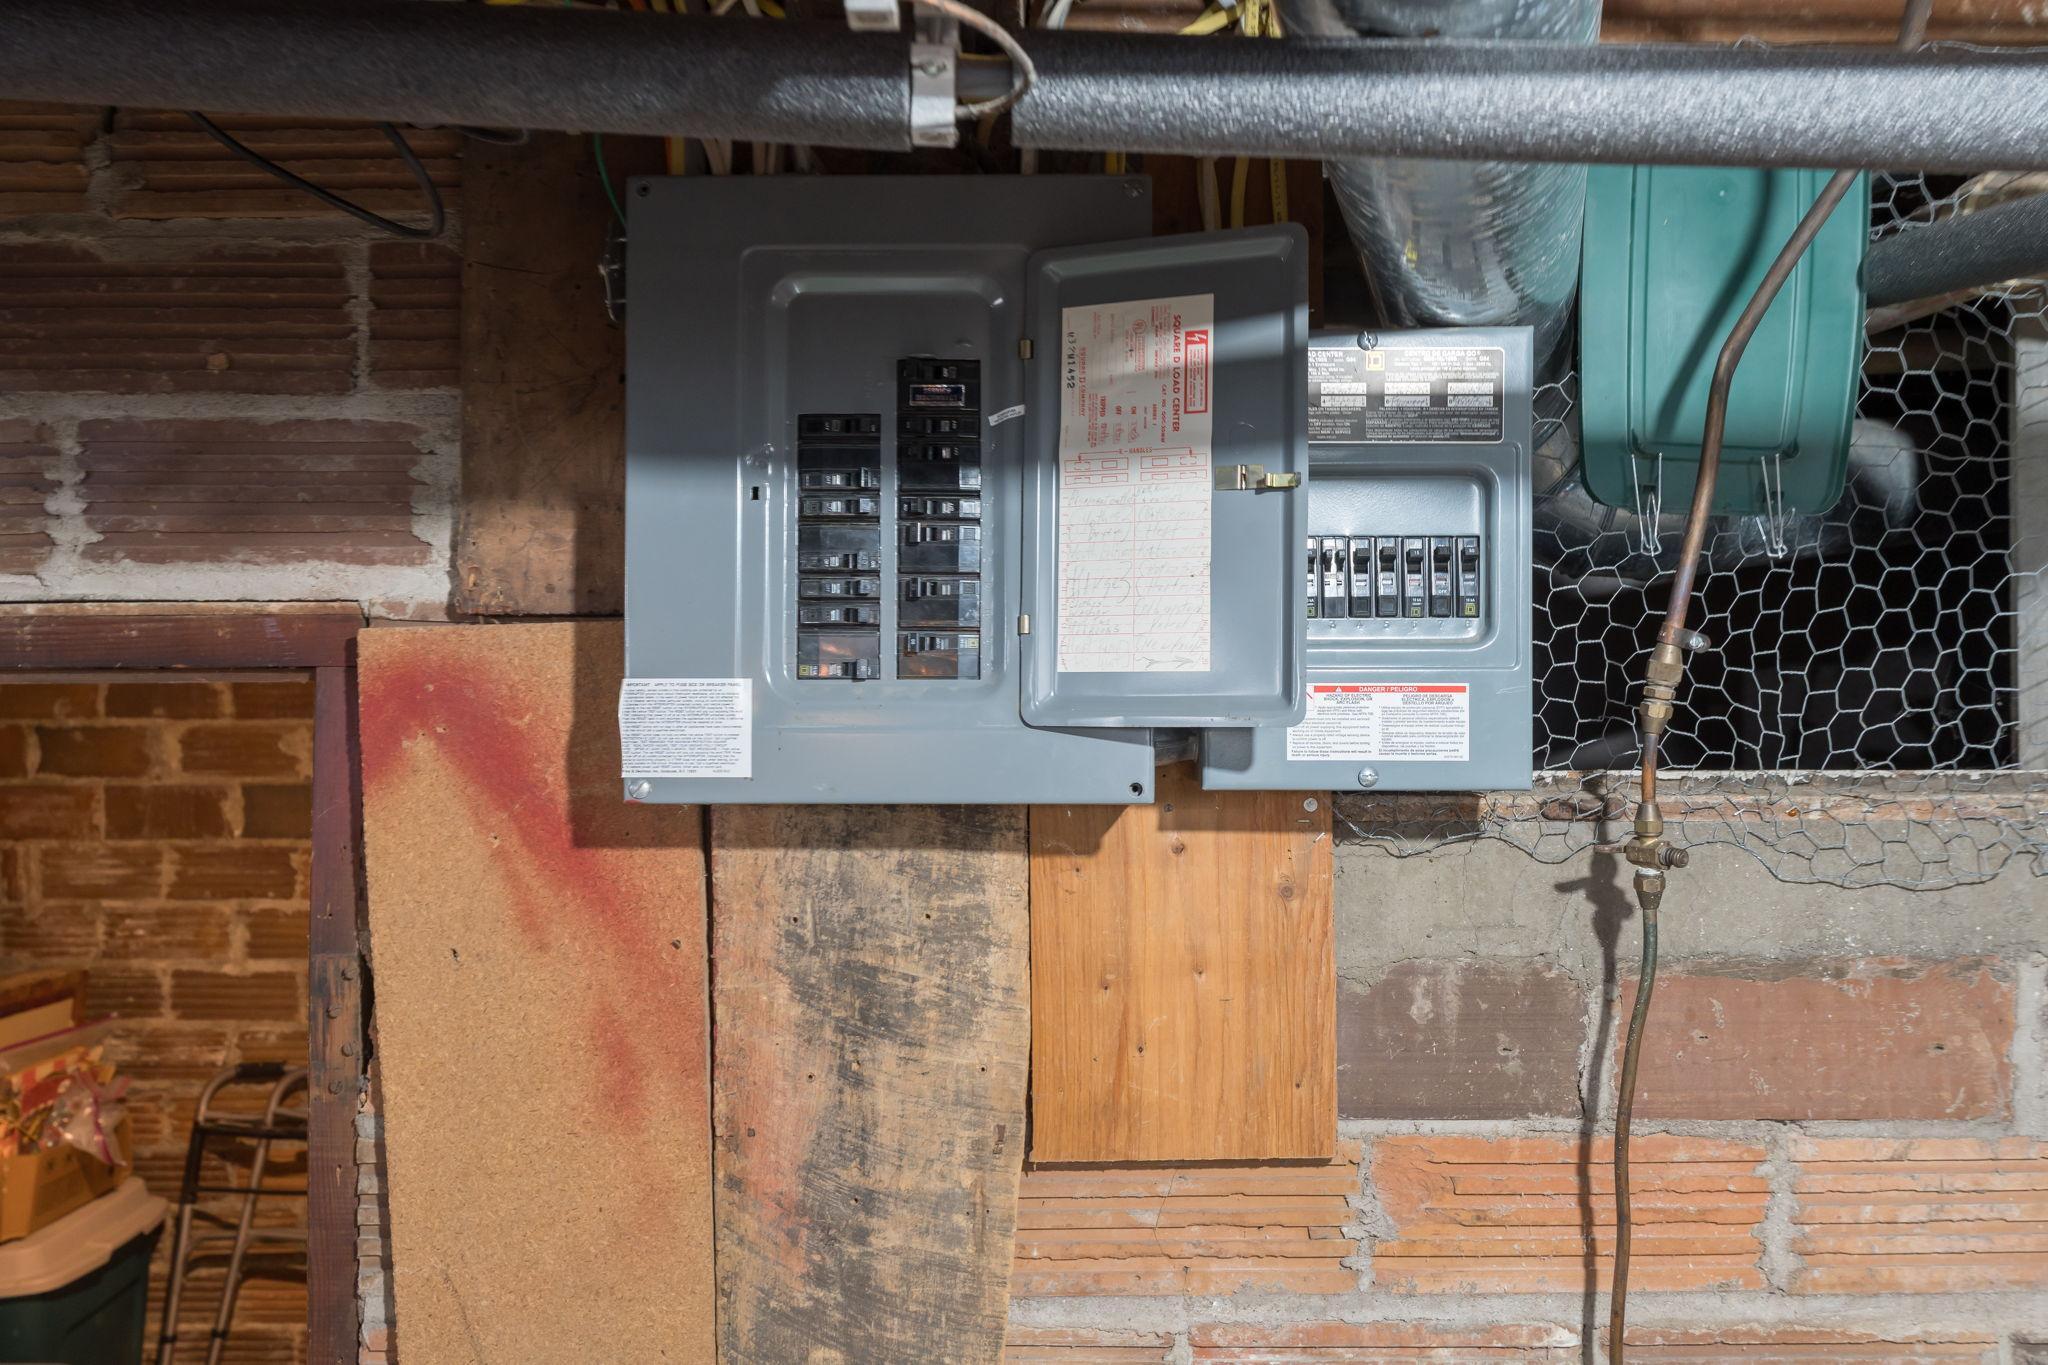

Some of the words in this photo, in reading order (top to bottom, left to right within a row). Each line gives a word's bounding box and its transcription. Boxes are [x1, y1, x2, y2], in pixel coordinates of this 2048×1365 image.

[1173, 314, 1181, 353] SQUARE
[1173, 356, 1180, 364] D
[1172, 366, 1180, 394] LOAD
[1172, 397, 1181, 433] CENTER
